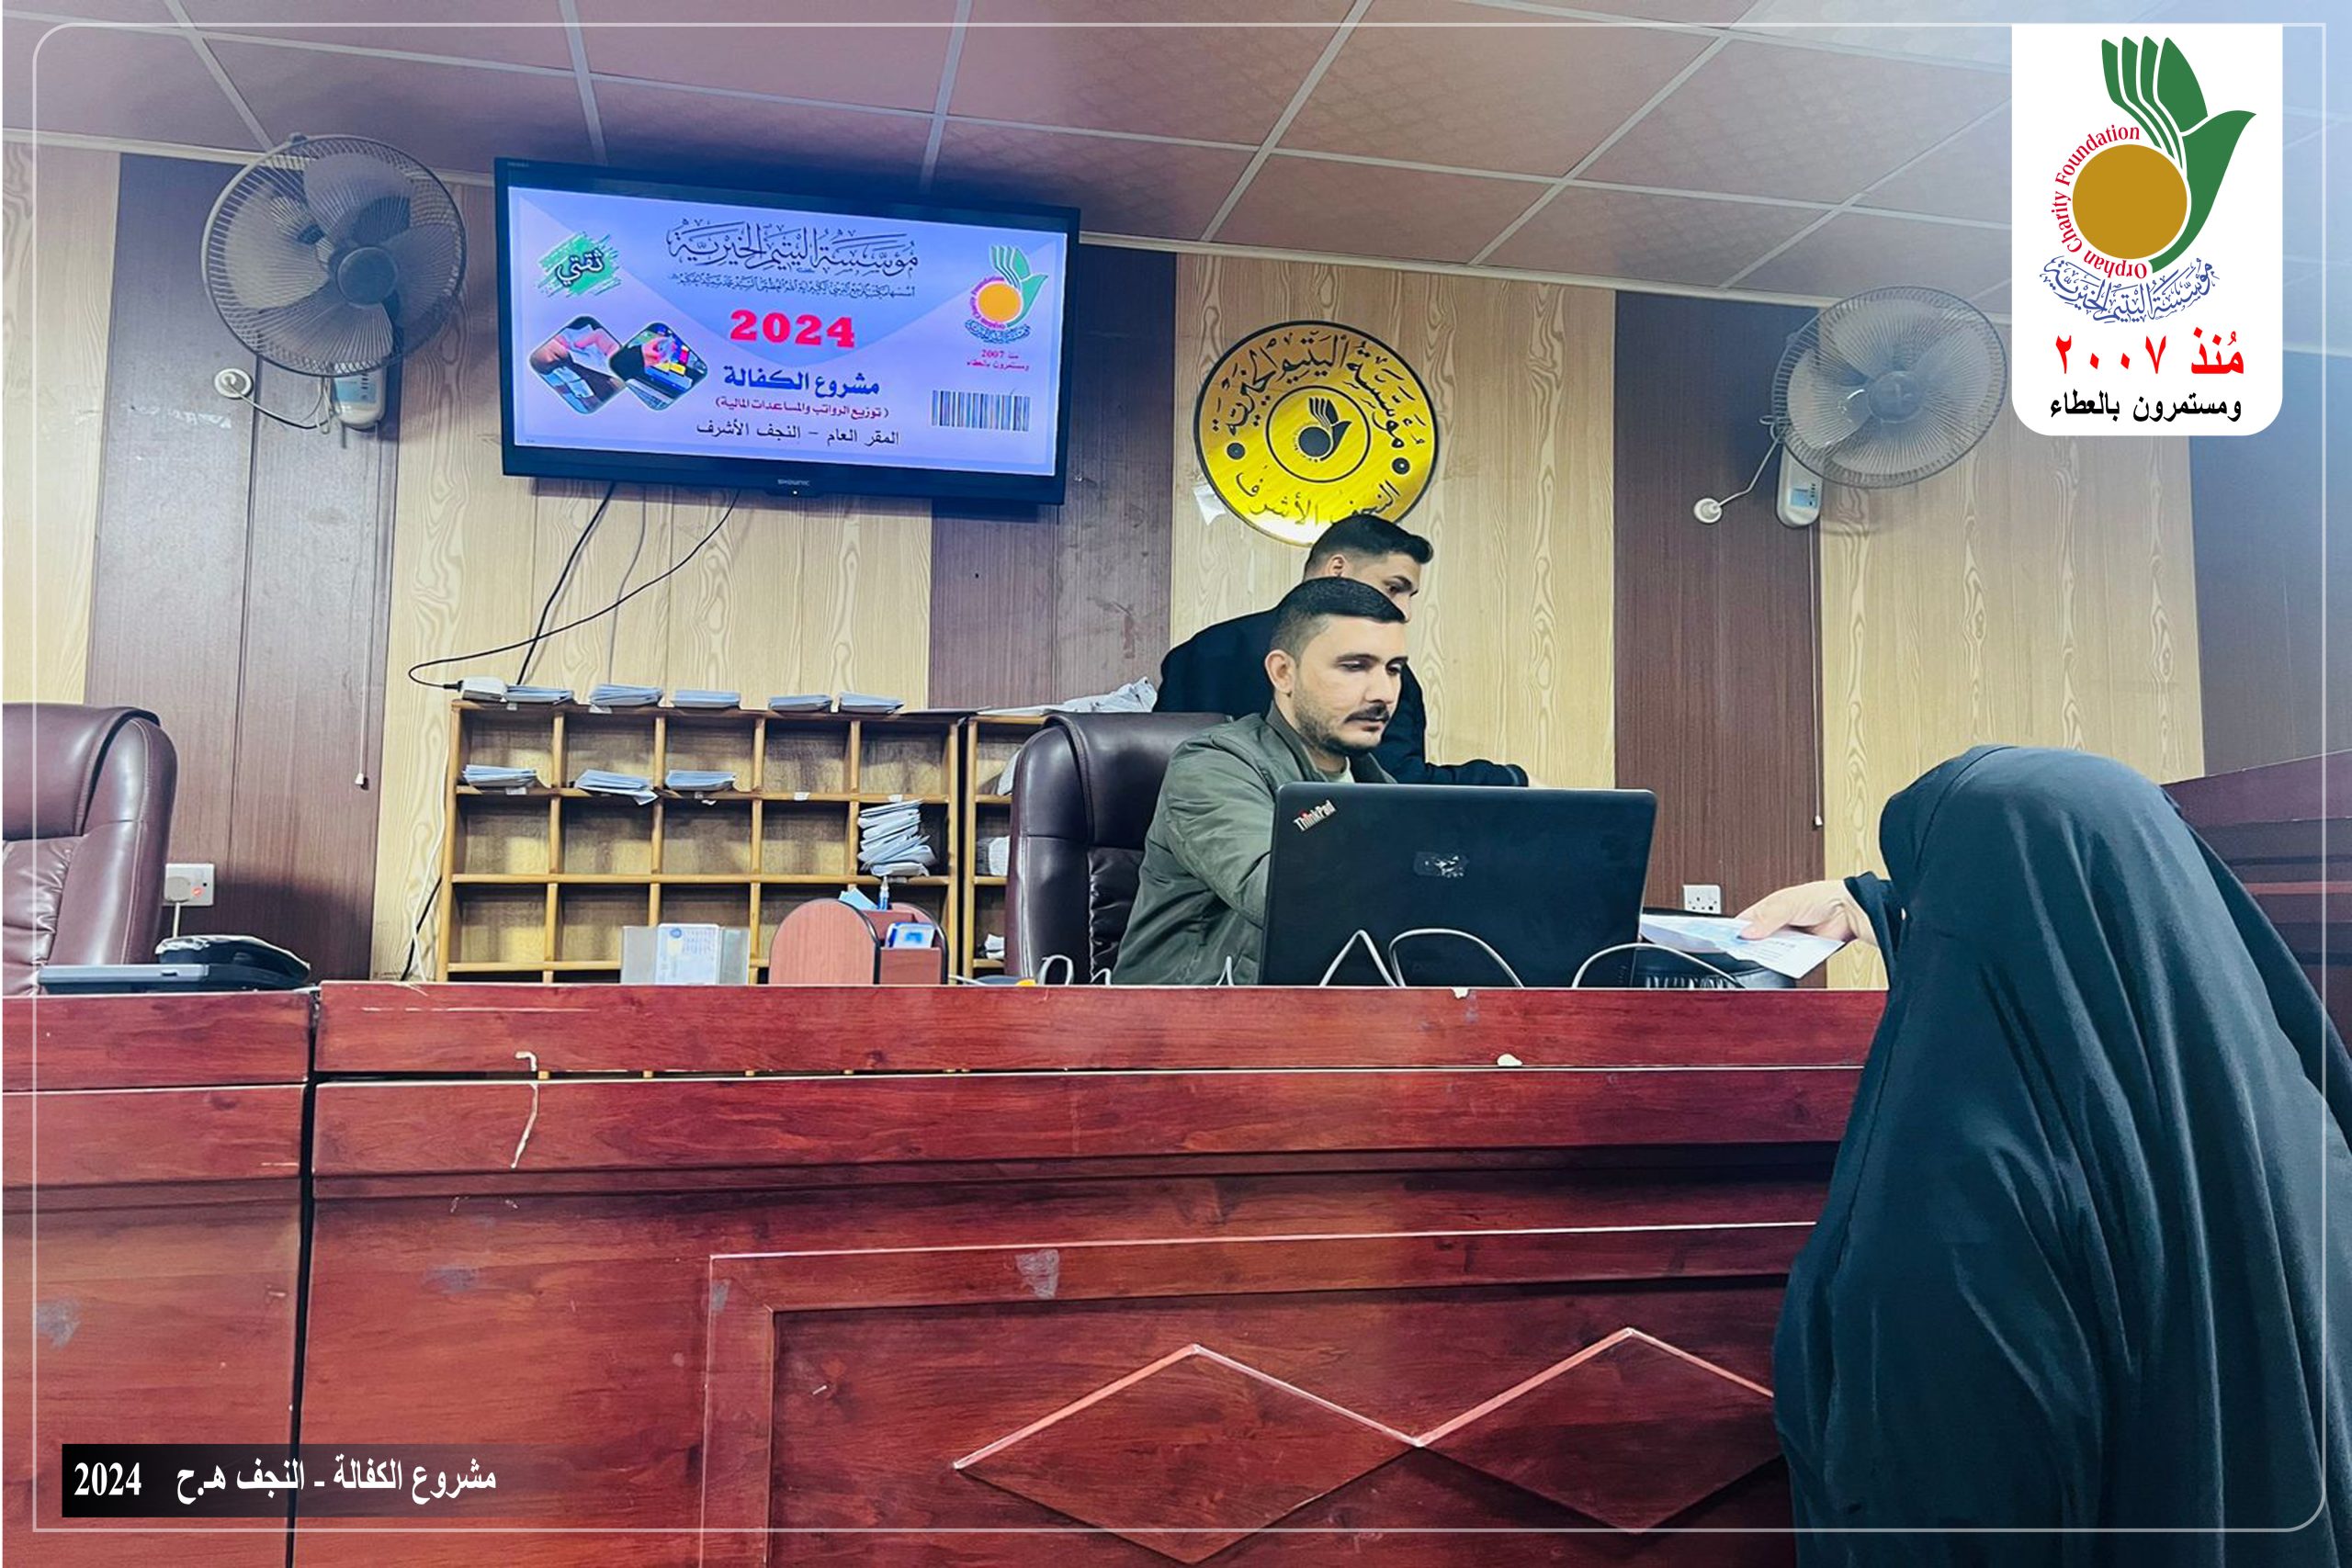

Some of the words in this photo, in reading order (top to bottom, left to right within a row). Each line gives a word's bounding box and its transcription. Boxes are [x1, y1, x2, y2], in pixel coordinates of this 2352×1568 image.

[555, 246, 605, 288] ثقتي
[729, 309, 855, 348] 2024
[723, 365, 809, 390] الكفالة
[814, 372, 880, 398] مشروع
[751, 398, 810, 415] والمساعدات
[811, 401, 850, 417] الرواتب
[695, 419, 750, 438] الأشرف
[756, 423, 801, 442] النجف
[826, 426, 858, 446] العام
[865, 430, 900, 447] المقر
[1293, 799, 1336, 830] ThinkPad
